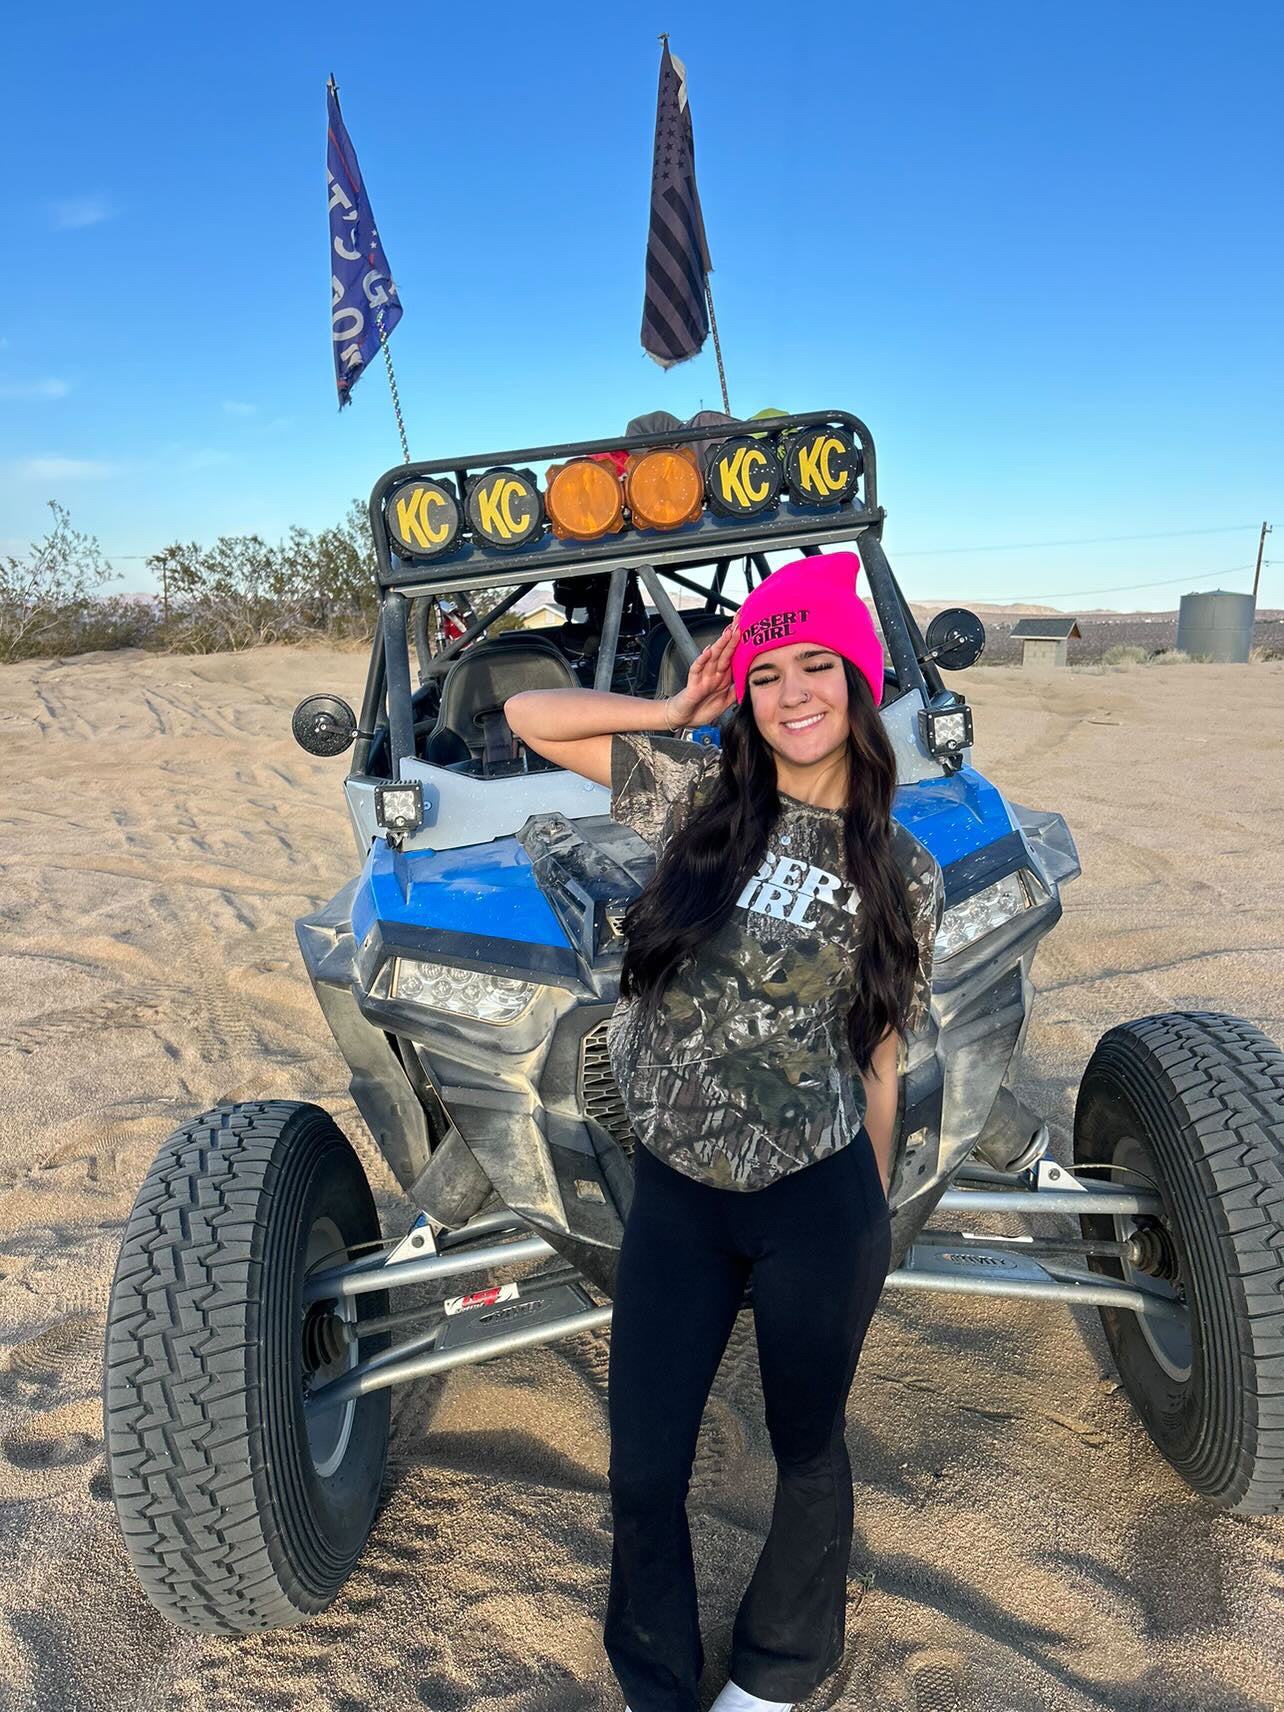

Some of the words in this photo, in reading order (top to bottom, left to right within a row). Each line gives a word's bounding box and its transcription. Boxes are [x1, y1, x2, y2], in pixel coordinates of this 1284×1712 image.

[719, 447, 769, 507] KC
[798, 435, 848, 496] KC
[396, 488, 449, 548] KC
[478, 479, 530, 539] KC
[742, 609, 809, 644] DESERT
[752, 623, 795, 646] GIRL
[735, 878, 817, 930] IRL
